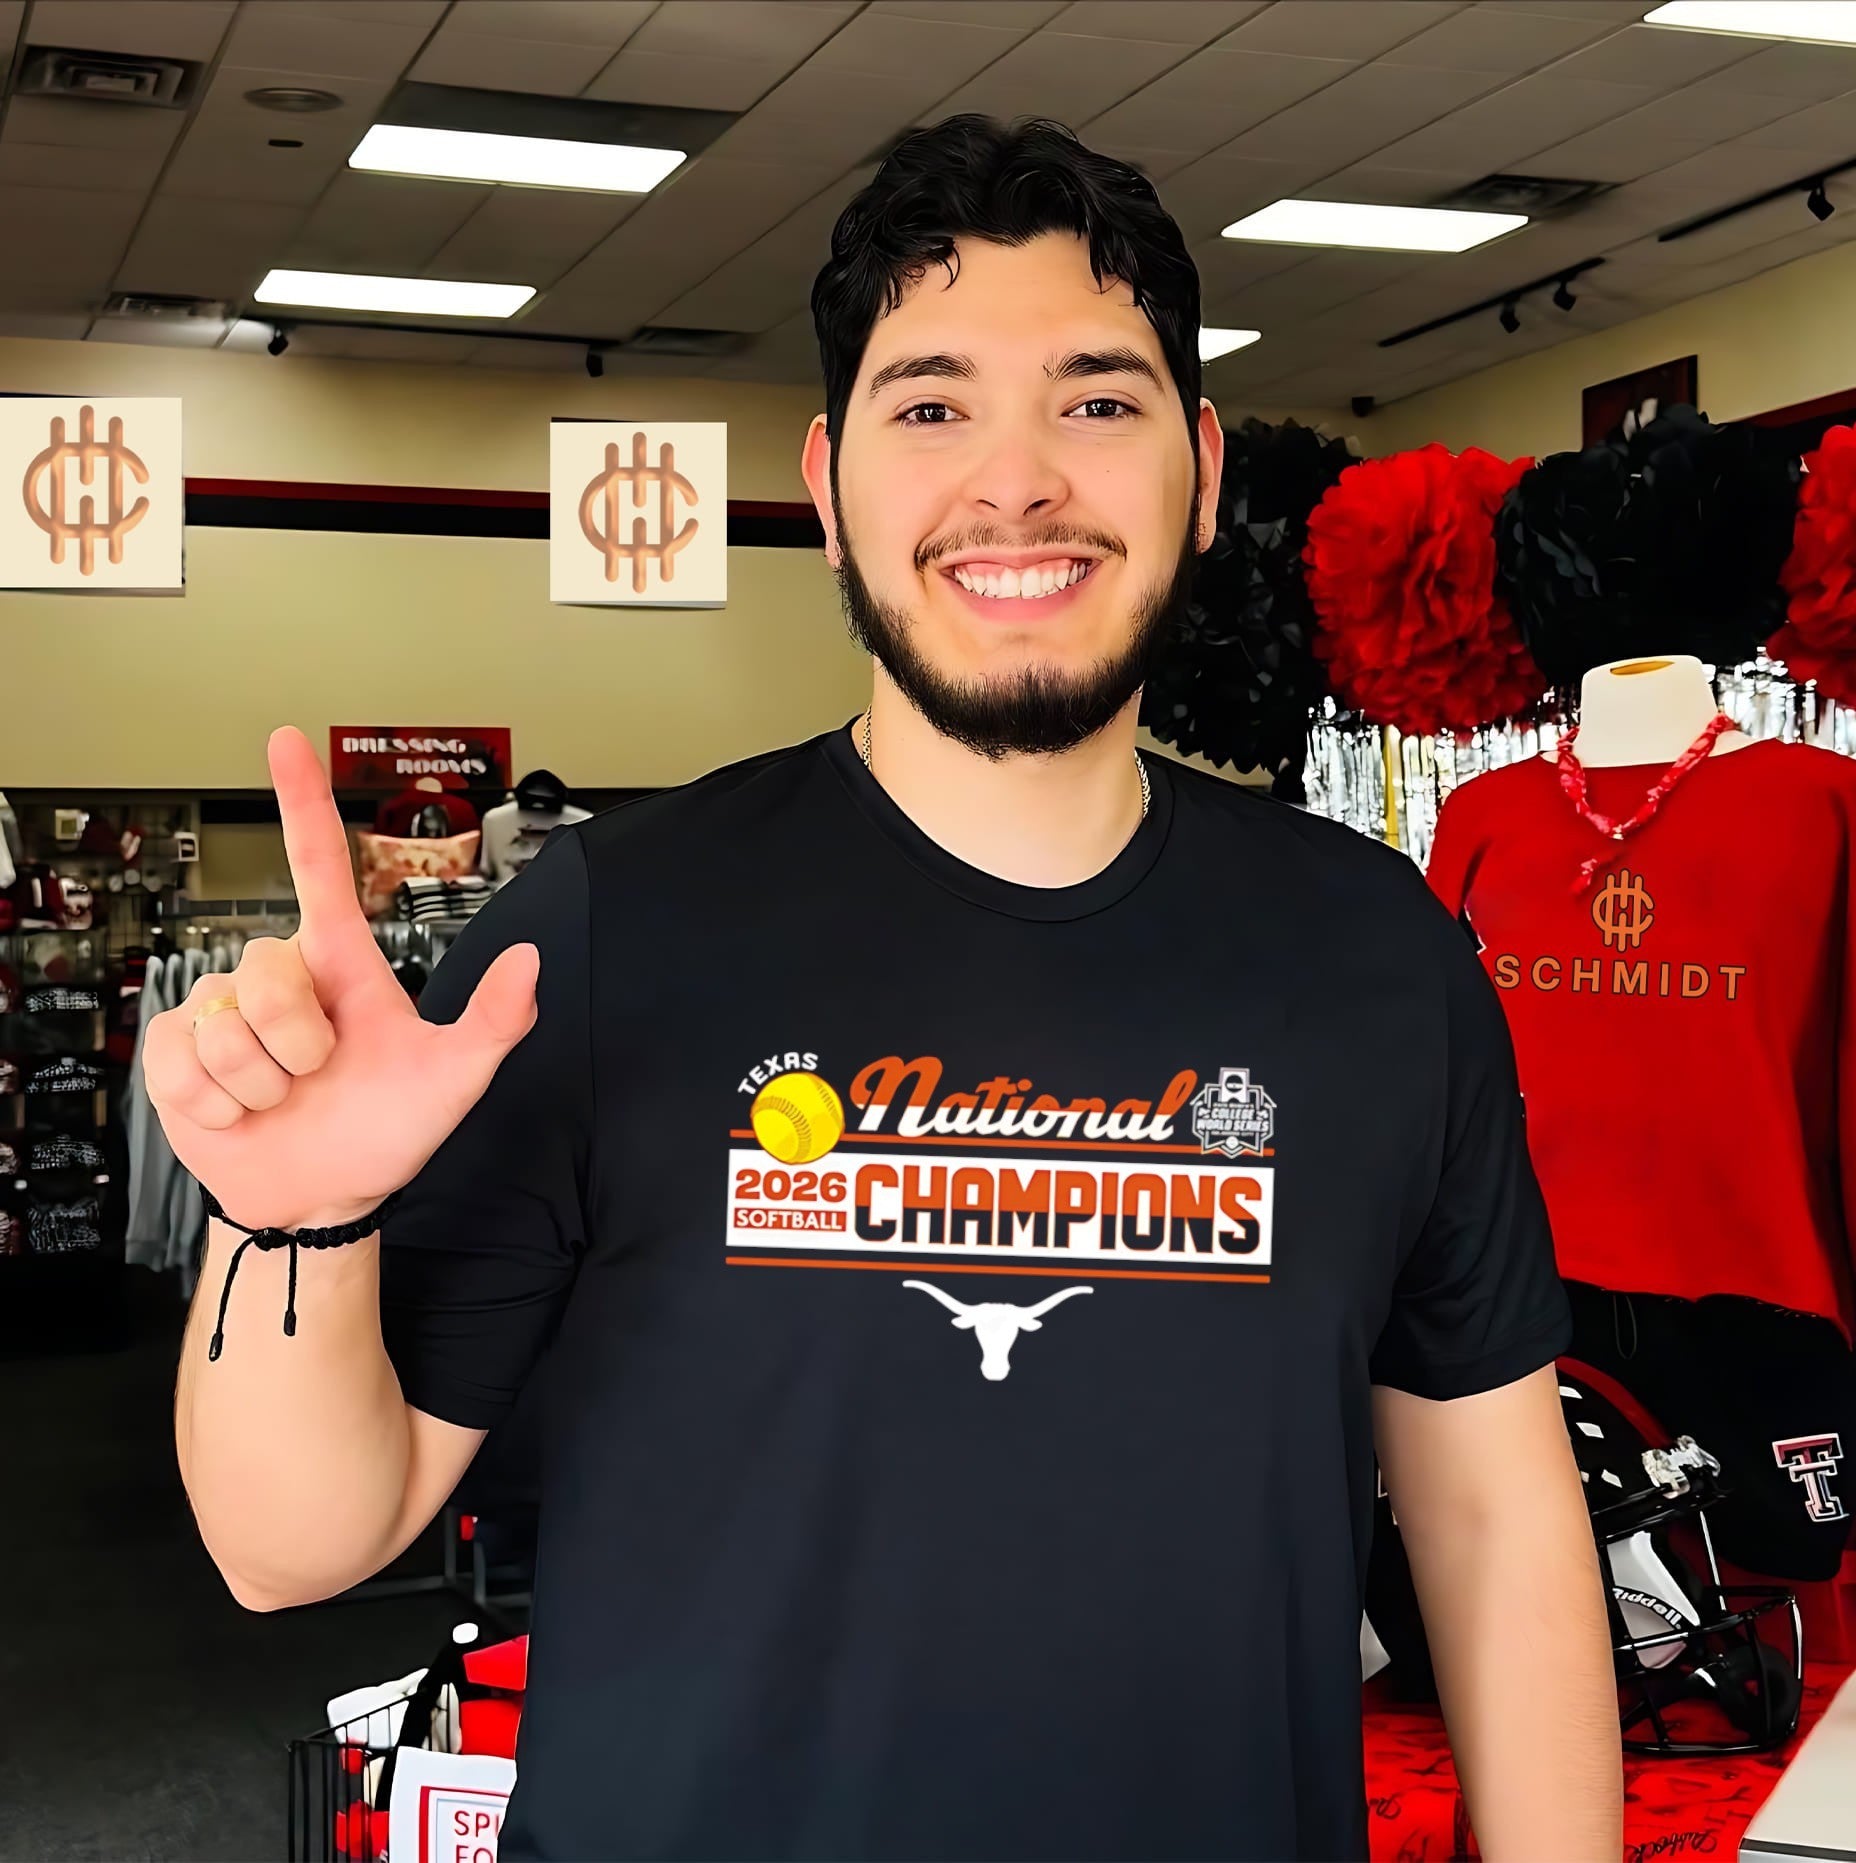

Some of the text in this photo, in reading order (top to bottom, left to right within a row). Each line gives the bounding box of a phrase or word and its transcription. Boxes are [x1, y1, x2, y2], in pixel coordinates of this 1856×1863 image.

[342, 737, 467, 753] DRESSING
[396, 758, 487, 775] ROOMS
[1494, 954, 1747, 1001] SCHMIDT
[737, 1051, 819, 1095] TEXAS
[850, 1055, 1198, 1142] National
[1196, 1118, 1233, 1131] WORLD
[1211, 1107, 1255, 1120] COLLEGE
[735, 1168, 848, 1203] 2026
[736, 1209, 843, 1230] SOFTBALL
[854, 1163, 1263, 1255] CHAMPIONS
